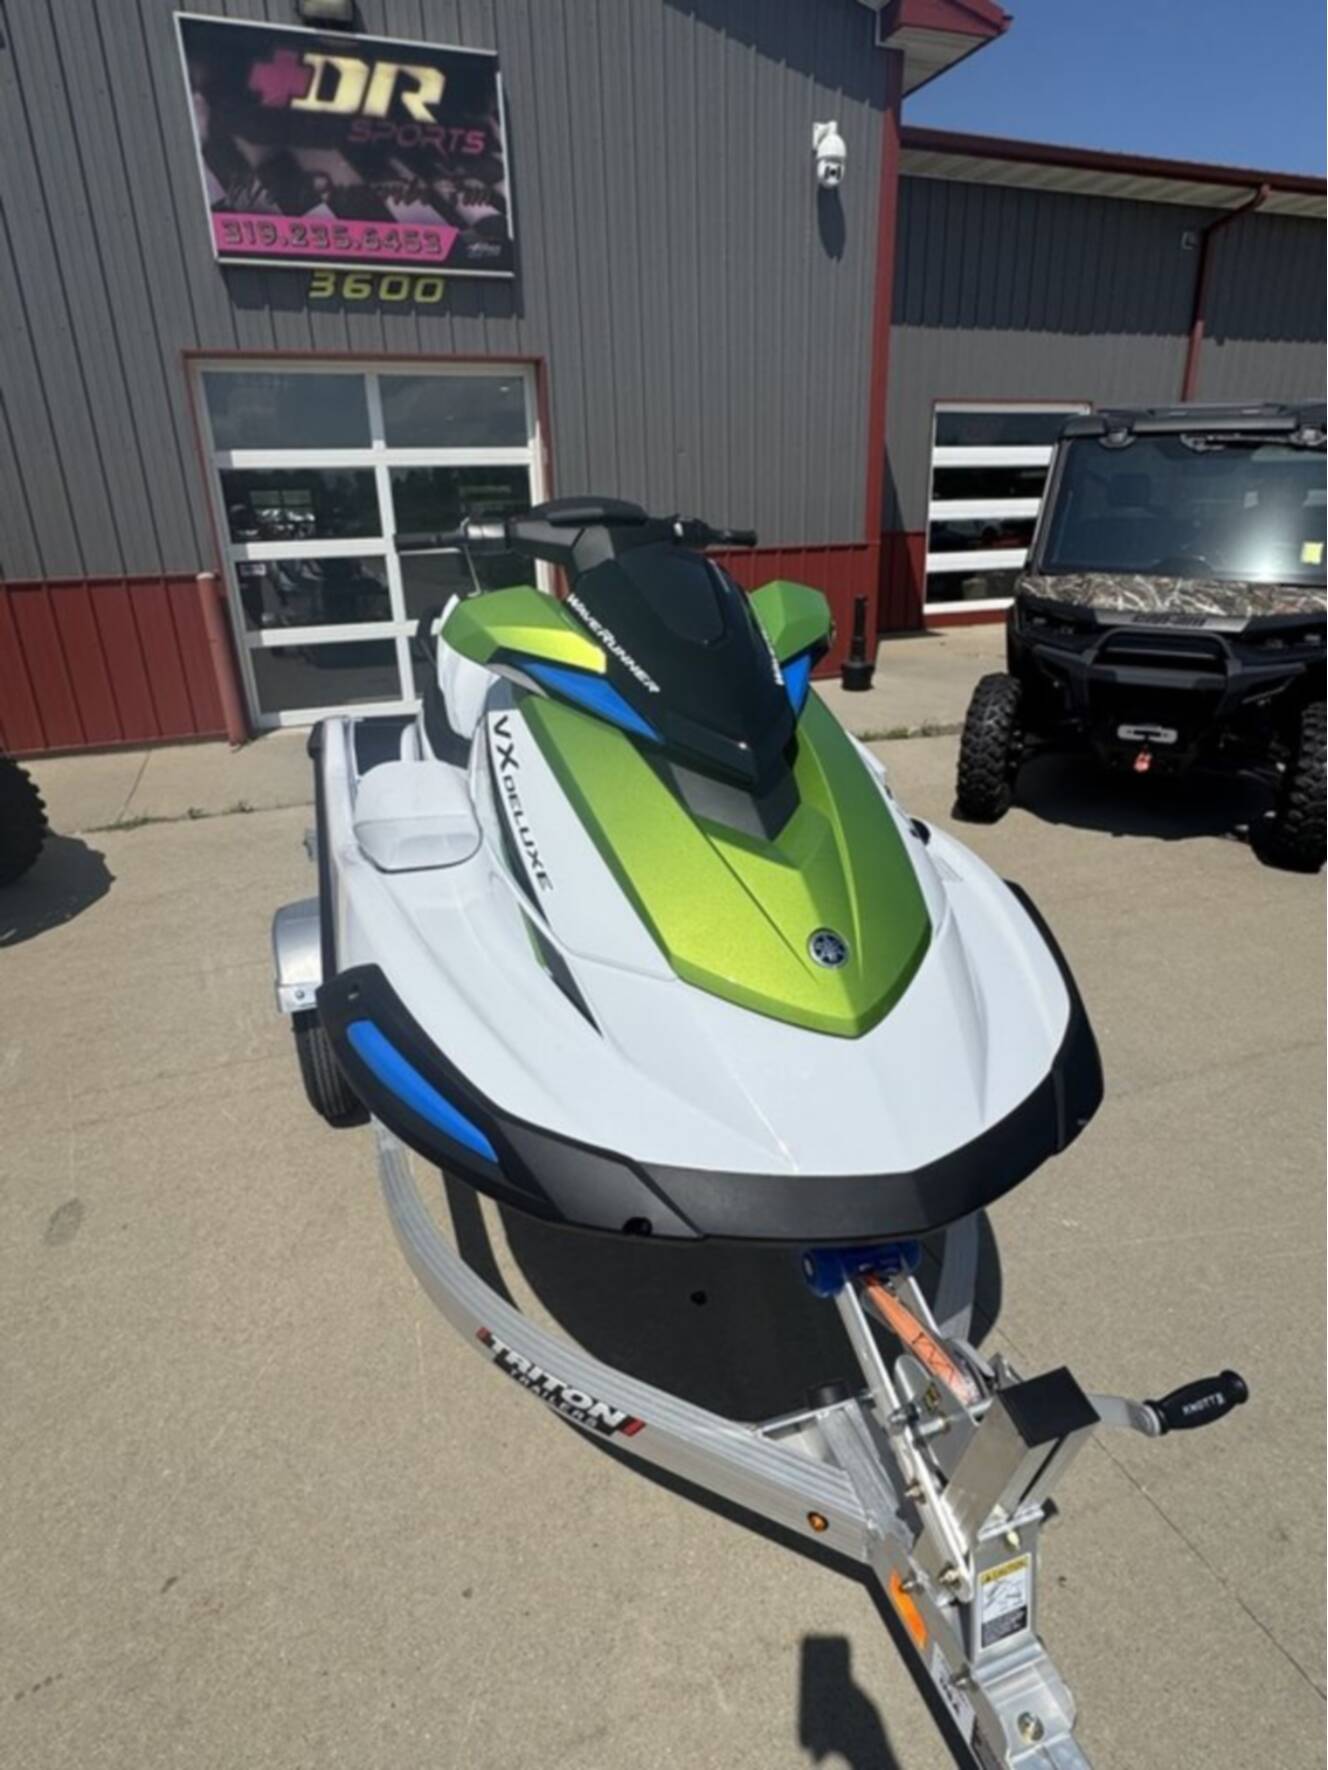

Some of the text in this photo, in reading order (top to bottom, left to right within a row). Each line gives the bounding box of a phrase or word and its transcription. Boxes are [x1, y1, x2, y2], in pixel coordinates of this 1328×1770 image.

[290, 53, 446, 124] DR
[349, 118, 486, 155] SPORTS
[309, 271, 445, 303] 3600
[493, 715, 553, 890] VX DELUXE
[492, 1335, 626, 1427] TRITON
